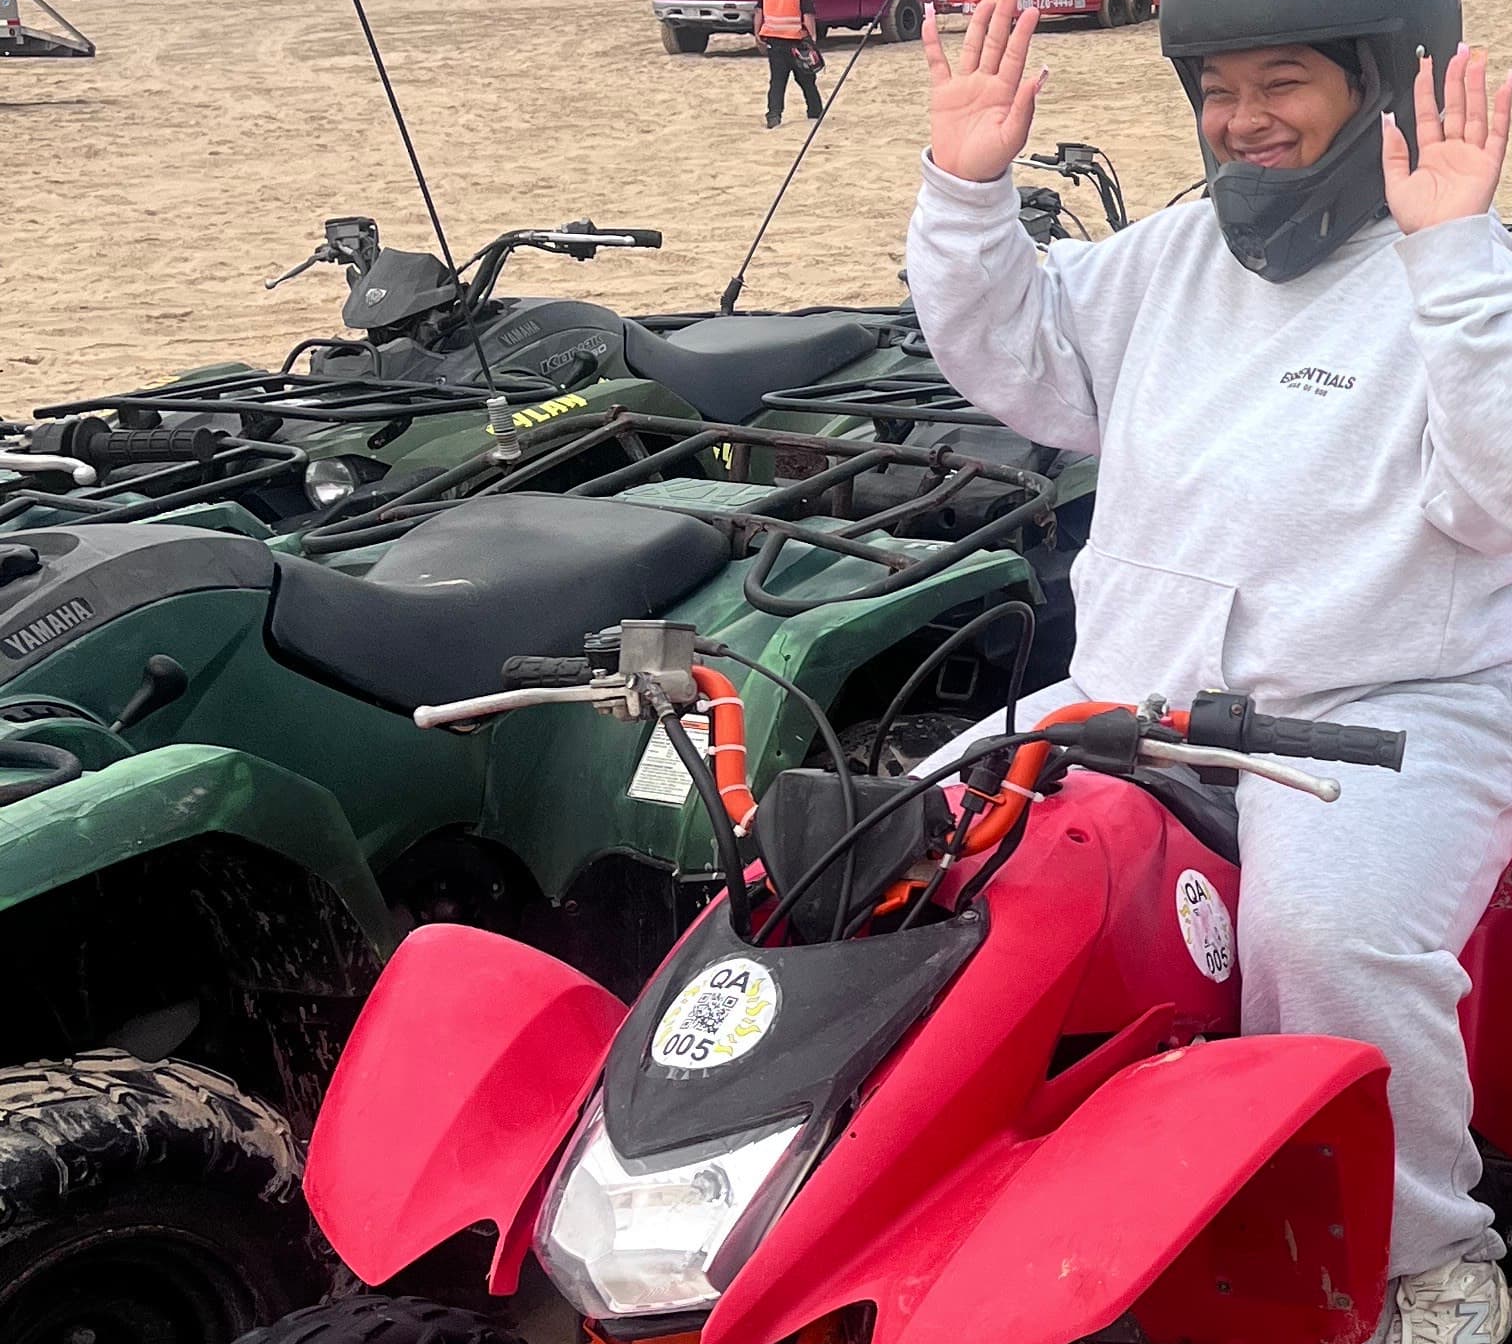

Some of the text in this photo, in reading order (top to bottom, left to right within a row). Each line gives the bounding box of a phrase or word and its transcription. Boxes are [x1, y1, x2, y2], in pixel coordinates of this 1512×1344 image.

[500, 320, 541, 346] YAMAHA
[3, 600, 94, 655] YAMAHA
[1184, 879, 1208, 905] QA
[1206, 947, 1229, 975] 005
[709, 968, 751, 993] QA
[662, 1034, 715, 1061] 005
